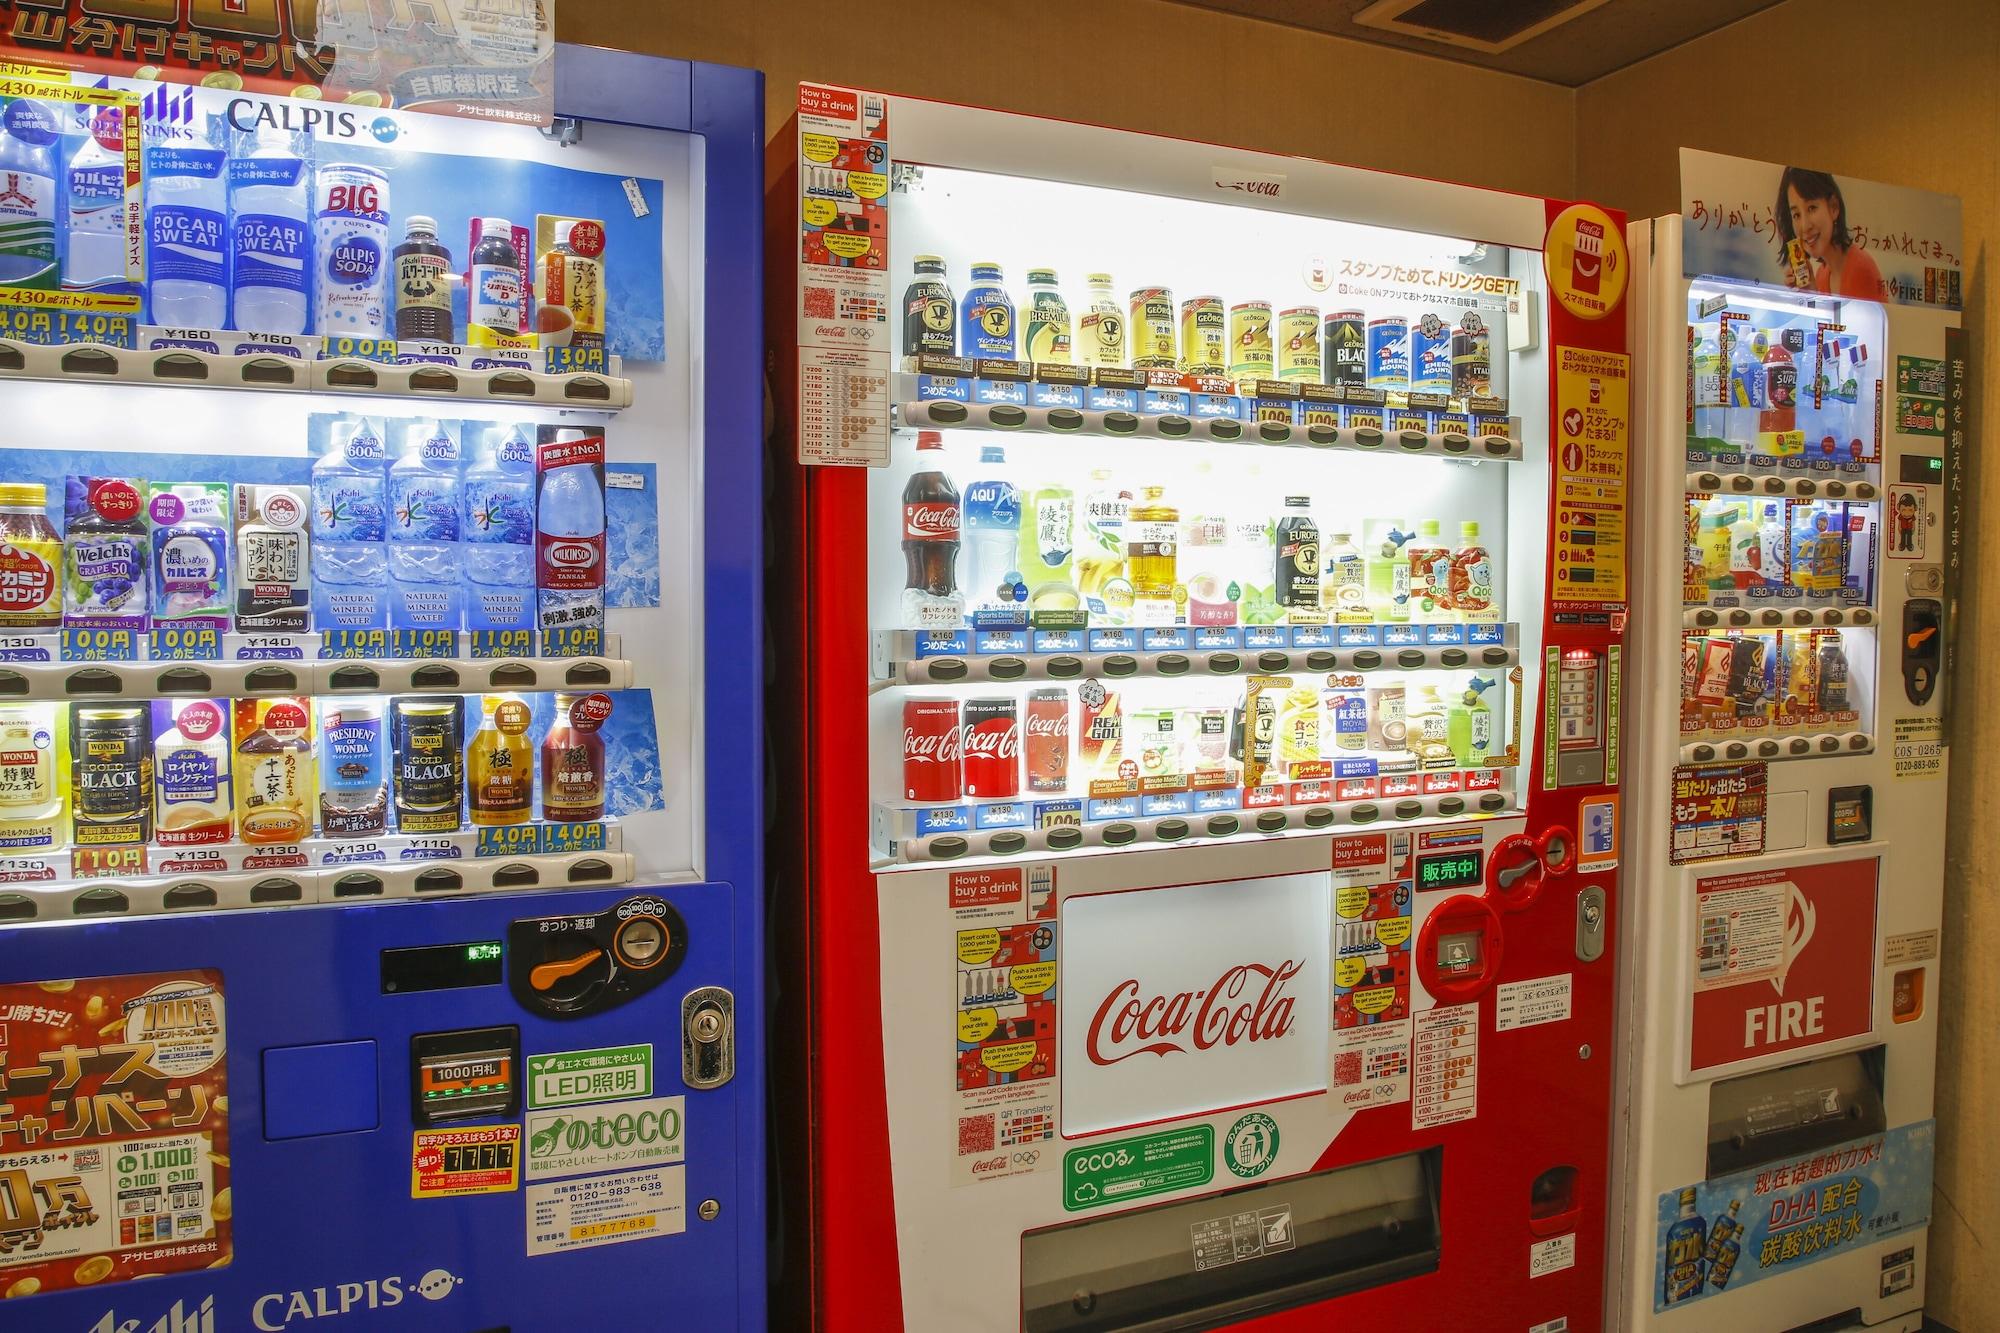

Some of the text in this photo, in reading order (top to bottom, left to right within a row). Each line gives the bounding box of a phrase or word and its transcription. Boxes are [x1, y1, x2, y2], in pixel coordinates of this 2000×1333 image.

[411, 72, 519, 96] 自販機限定
[801, 88, 831, 100] How to
[801, 96, 820, 109] buy
[830, 100, 855, 112] drink
[228, 99, 356, 138] CALPIS
[456, 103, 542, 123] アサヒ飲料株式会社
[127, 116, 140, 173] 自販機限定
[328, 185, 379, 214] BIG
[354, 208, 384, 221] サイズ
[1691, 200, 1777, 243] ありがとう
[154, 215, 224, 236] POCARI
[237, 222, 303, 244] POCARI
[127, 202, 141, 266] お手軽サイズ
[154, 229, 218, 247] SWEAT
[237, 238, 297, 254] SWEAT
[336, 247, 375, 262] CALPIS
[336, 260, 375, 276] SODA
[1339, 259, 1519, 295] スタンプためて、ドリンクGET!
[572, 260, 583, 313] ほうじ茶
[1899, 285, 1923, 301] FIRE
[1348, 285, 1479, 309] Coke ONアプリでおトクなスマホ自販機
[1030, 310, 1071, 322] PREMIUM
[59, 313, 129, 336] 140円
[815, 325, 846, 337] Coca-Cola
[165, 329, 211, 341] ¥160
[248, 332, 292, 345] ¥160
[421, 345, 461, 356] ¥130
[499, 351, 528, 359] ¥160
[547, 348, 604, 365] 130円
[923, 354, 961, 365] Black Coffee
[982, 360, 1004, 368] Coffee
[934, 378, 956, 387] ¥140
[993, 382, 1014, 391] ¥150
[1106, 390, 1125, 398] ¥160
[1309, 405, 1333, 413] COLD
[347, 446, 384, 459] 600ml
[423, 447, 458, 459] 600ml
[100, 501, 133, 510] すっきり
[156, 499, 176, 509] 期間
[350, 504, 382, 515] 天然水
[156, 509, 176, 517] 限定
[1040, 506, 1058, 542] 綾鷹
[76, 543, 130, 561] Welch's
[554, 548, 590, 561] WILKINSON
[79, 562, 127, 576] GRAPE 50
[166, 567, 208, 578] カルピス
[257, 585, 288, 595] WONDA
[406, 592, 448, 601] NATURAL
[330, 595, 375, 603] NATURAL
[332, 605, 374, 613] MINERAL
[407, 603, 447, 612] MINERAL
[542, 603, 601, 625] 刺激、強め。
[337, 615, 371, 625] WATER
[412, 613, 444, 622] WATER
[977, 612, 1014, 620] Sports Drink
[62, 630, 130, 648] 100円
[151, 630, 216, 648] 100円
[248, 638, 290, 647] ¥140
[323, 630, 386, 647] 110円
[392, 630, 452, 647] 110円
[472, 630, 530, 647] 110円
[932, 631, 953, 640] ¥160
[275, 720, 295, 728] ゼロ
[329, 726, 376, 743] PRESIDENT
[413, 737, 442, 746] WONDA
[91, 743, 121, 752] WONDA
[334, 743, 369, 754] WONDA
[2, 752, 36, 762] WONDA
[489, 749, 513, 769] 極
[168, 761, 209, 772] ロイヤル
[403, 763, 451, 780] BLACK
[1895, 759, 1940, 771] 0120-883-065
[4, 767, 36, 781] 特製
[81, 770, 136, 788] BLACK
[165, 772, 214, 784] ミルクティー
[265, 757, 284, 801] 十六茶
[284, 754, 295, 797] あったまる
[490, 775, 513, 785] 微糖
[1677, 771, 1693, 779] KIRIN
[491, 787, 512, 796] WONDA
[1093, 780, 1127, 790] Energy Drink
[1676, 777, 1747, 799] 当たりが出たら
[1675, 796, 1735, 821] もう一本!!
[81, 834, 134, 842] プレミアムブラック
[158, 831, 224, 842] 北海道産 生クリーム
[479, 827, 536, 843] 140円
[254, 846, 298, 856] ¥130
[335, 843, 377, 854] ¥130
[410, 839, 450, 848] ¥110
[1335, 840, 1352, 848] How
[175, 850, 220, 860] ¥130
[1335, 849, 1351, 859] buy
[1362, 846, 1384, 856] drink
[1423, 859, 1473, 882] 販売中
[955, 874, 990, 885] How to
[955, 886, 976, 897] buy
[990, 882, 1019, 893] drink
[468, 945, 501, 960] 販売中
[1086, 958, 1306, 1066] Coca-Cola
[1744, 995, 1825, 1048] FIRE
[556, 1053, 645, 1071] 省エネで環境にやさしい
[437, 1063, 496, 1080] 1000円札
[544, 1070, 637, 1100] LED照明
[1344, 1088, 1372, 1103] Coca-Cola
[1001, 1104, 1054, 1118] QR Translator
[417, 1128, 519, 1146] 数字がそろえばもう1本!
[565, 1108, 681, 1151] のむeco
[417, 1154, 442, 1169] 当り!
[530, 1145, 680, 1171] 環境にやさしいヒートポンプ自動販売機
[972, 1157, 1007, 1173] Coca-Cola
[1754, 1136, 1885, 1196] 现在话题的力水!
[420, 1175, 445, 1187] ご注意
[553, 1173, 659, 1195] 自販機に関するお問い合わせは
[1768, 1178, 1862, 1226] DHA 配合
[536, 1217, 647, 1243] 管理番号 8177768
[1759, 1210, 1862, 1268] 碳酸饮料水
[121, 1242, 218, 1264] アサヒ飲料株式会社
[252, 1276, 404, 1332] CALPIS
